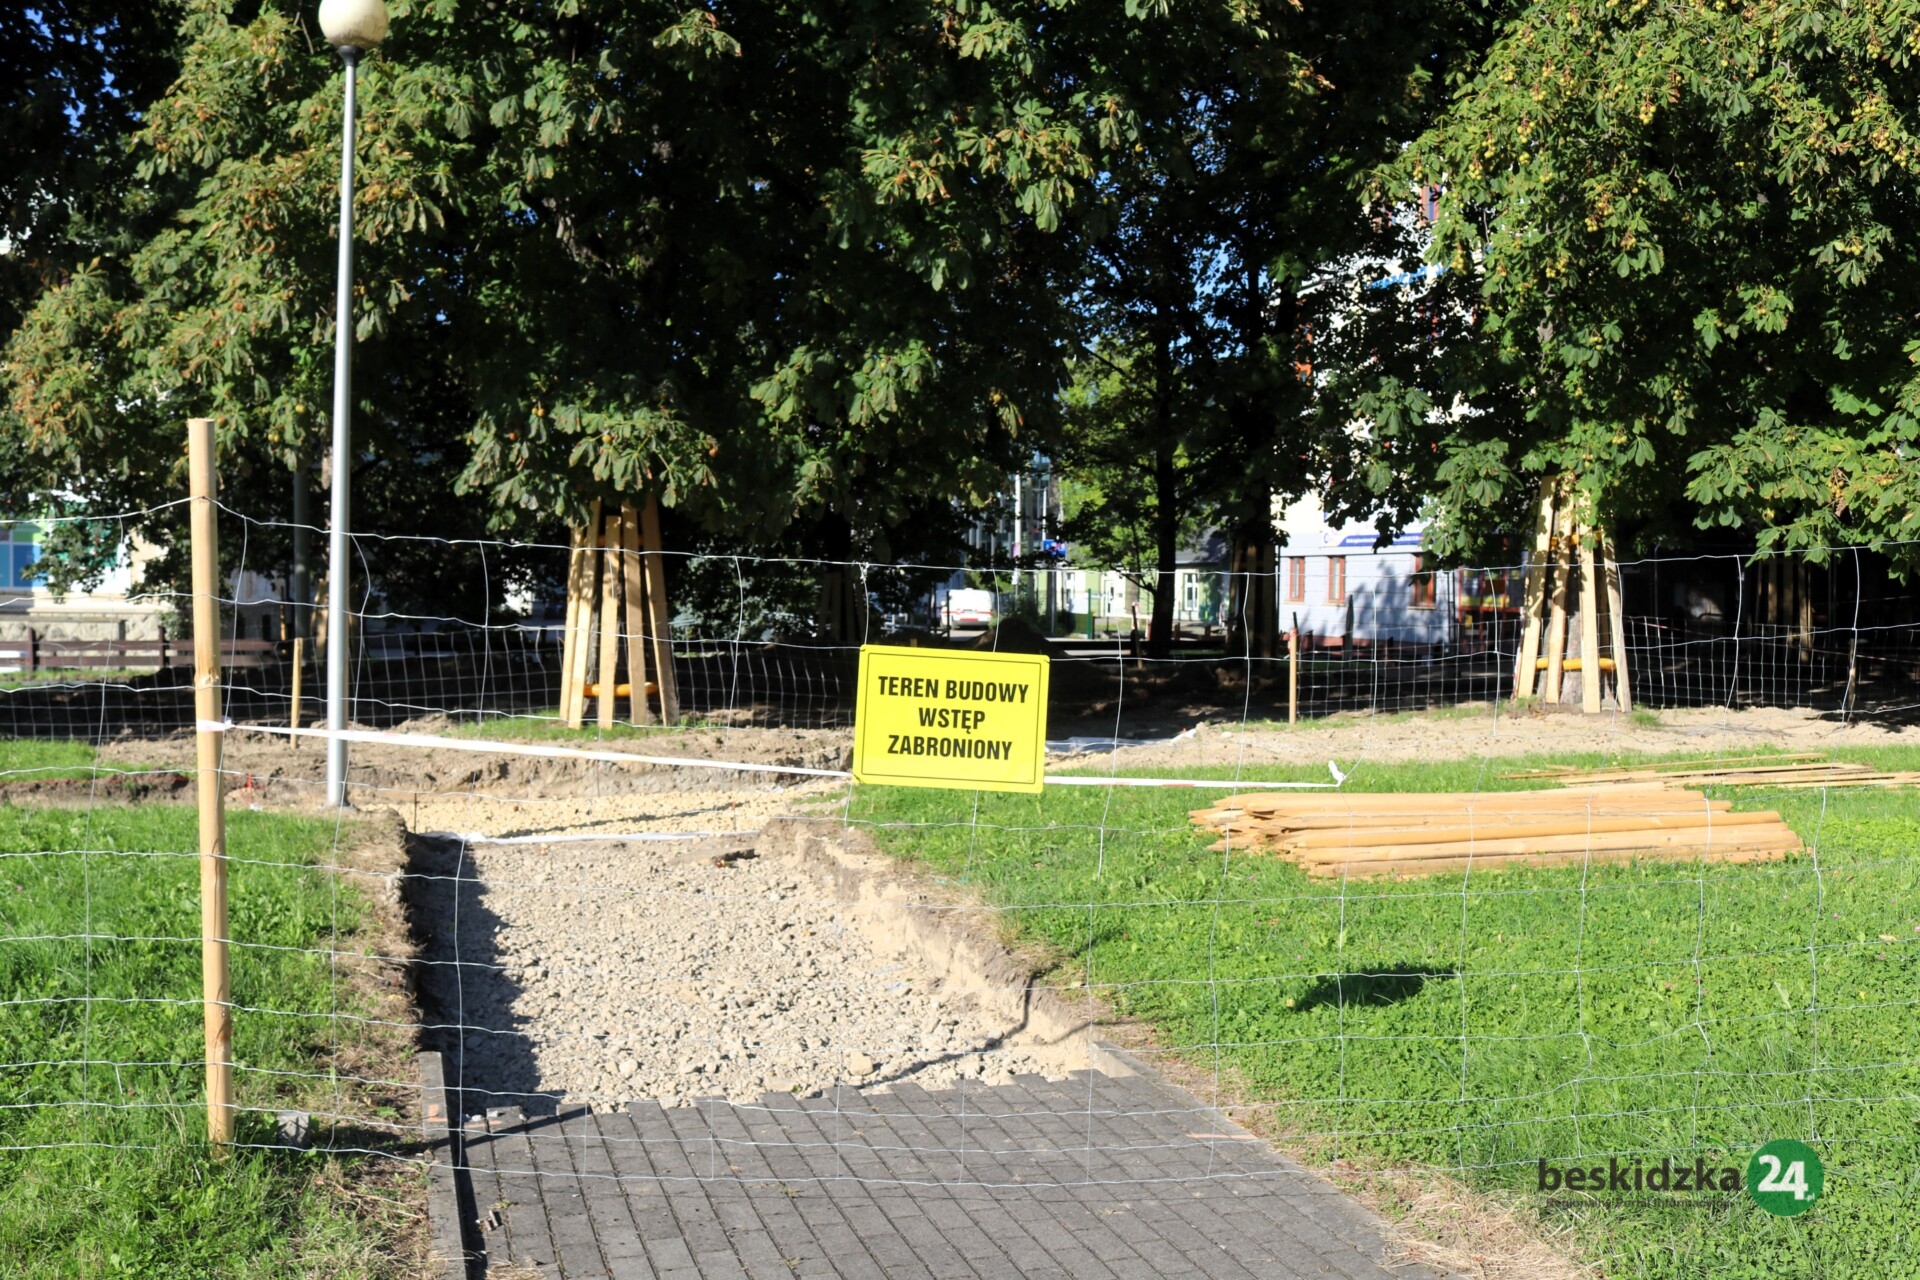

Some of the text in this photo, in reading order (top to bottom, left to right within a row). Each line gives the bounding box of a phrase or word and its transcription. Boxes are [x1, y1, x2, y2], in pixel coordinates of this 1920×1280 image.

[878, 675, 1029, 704] TEREN BUDOWY
[918, 707, 986, 734] WSTĘP
[887, 734, 1013, 761] ZABRONIONY
